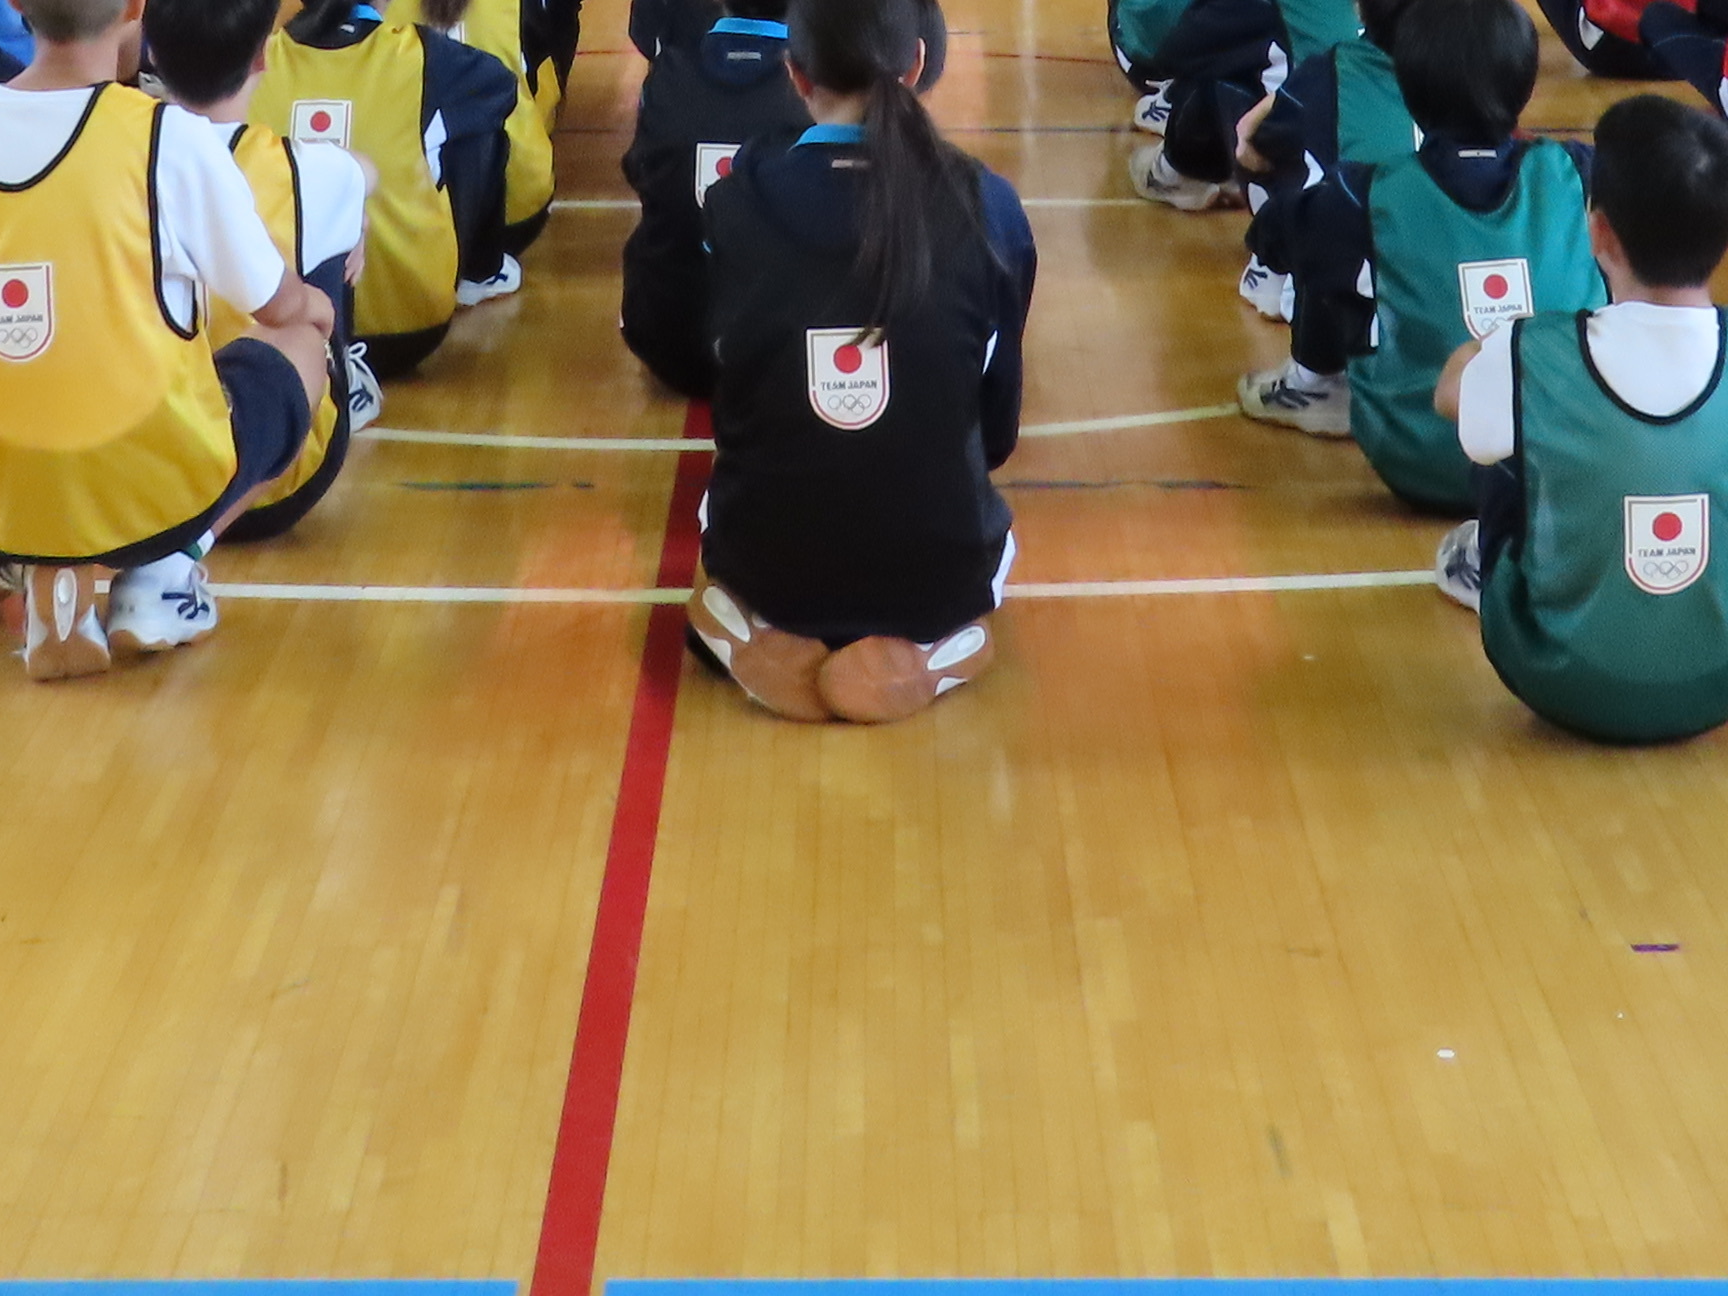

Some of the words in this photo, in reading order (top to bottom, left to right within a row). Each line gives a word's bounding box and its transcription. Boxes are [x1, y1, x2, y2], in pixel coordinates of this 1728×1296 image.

[821, 381, 846, 391] TEAM
[848, 379, 878, 389] JAPAN
[1638, 548, 1664, 557] TEAM
[1666, 547, 1696, 556] JAPAN
